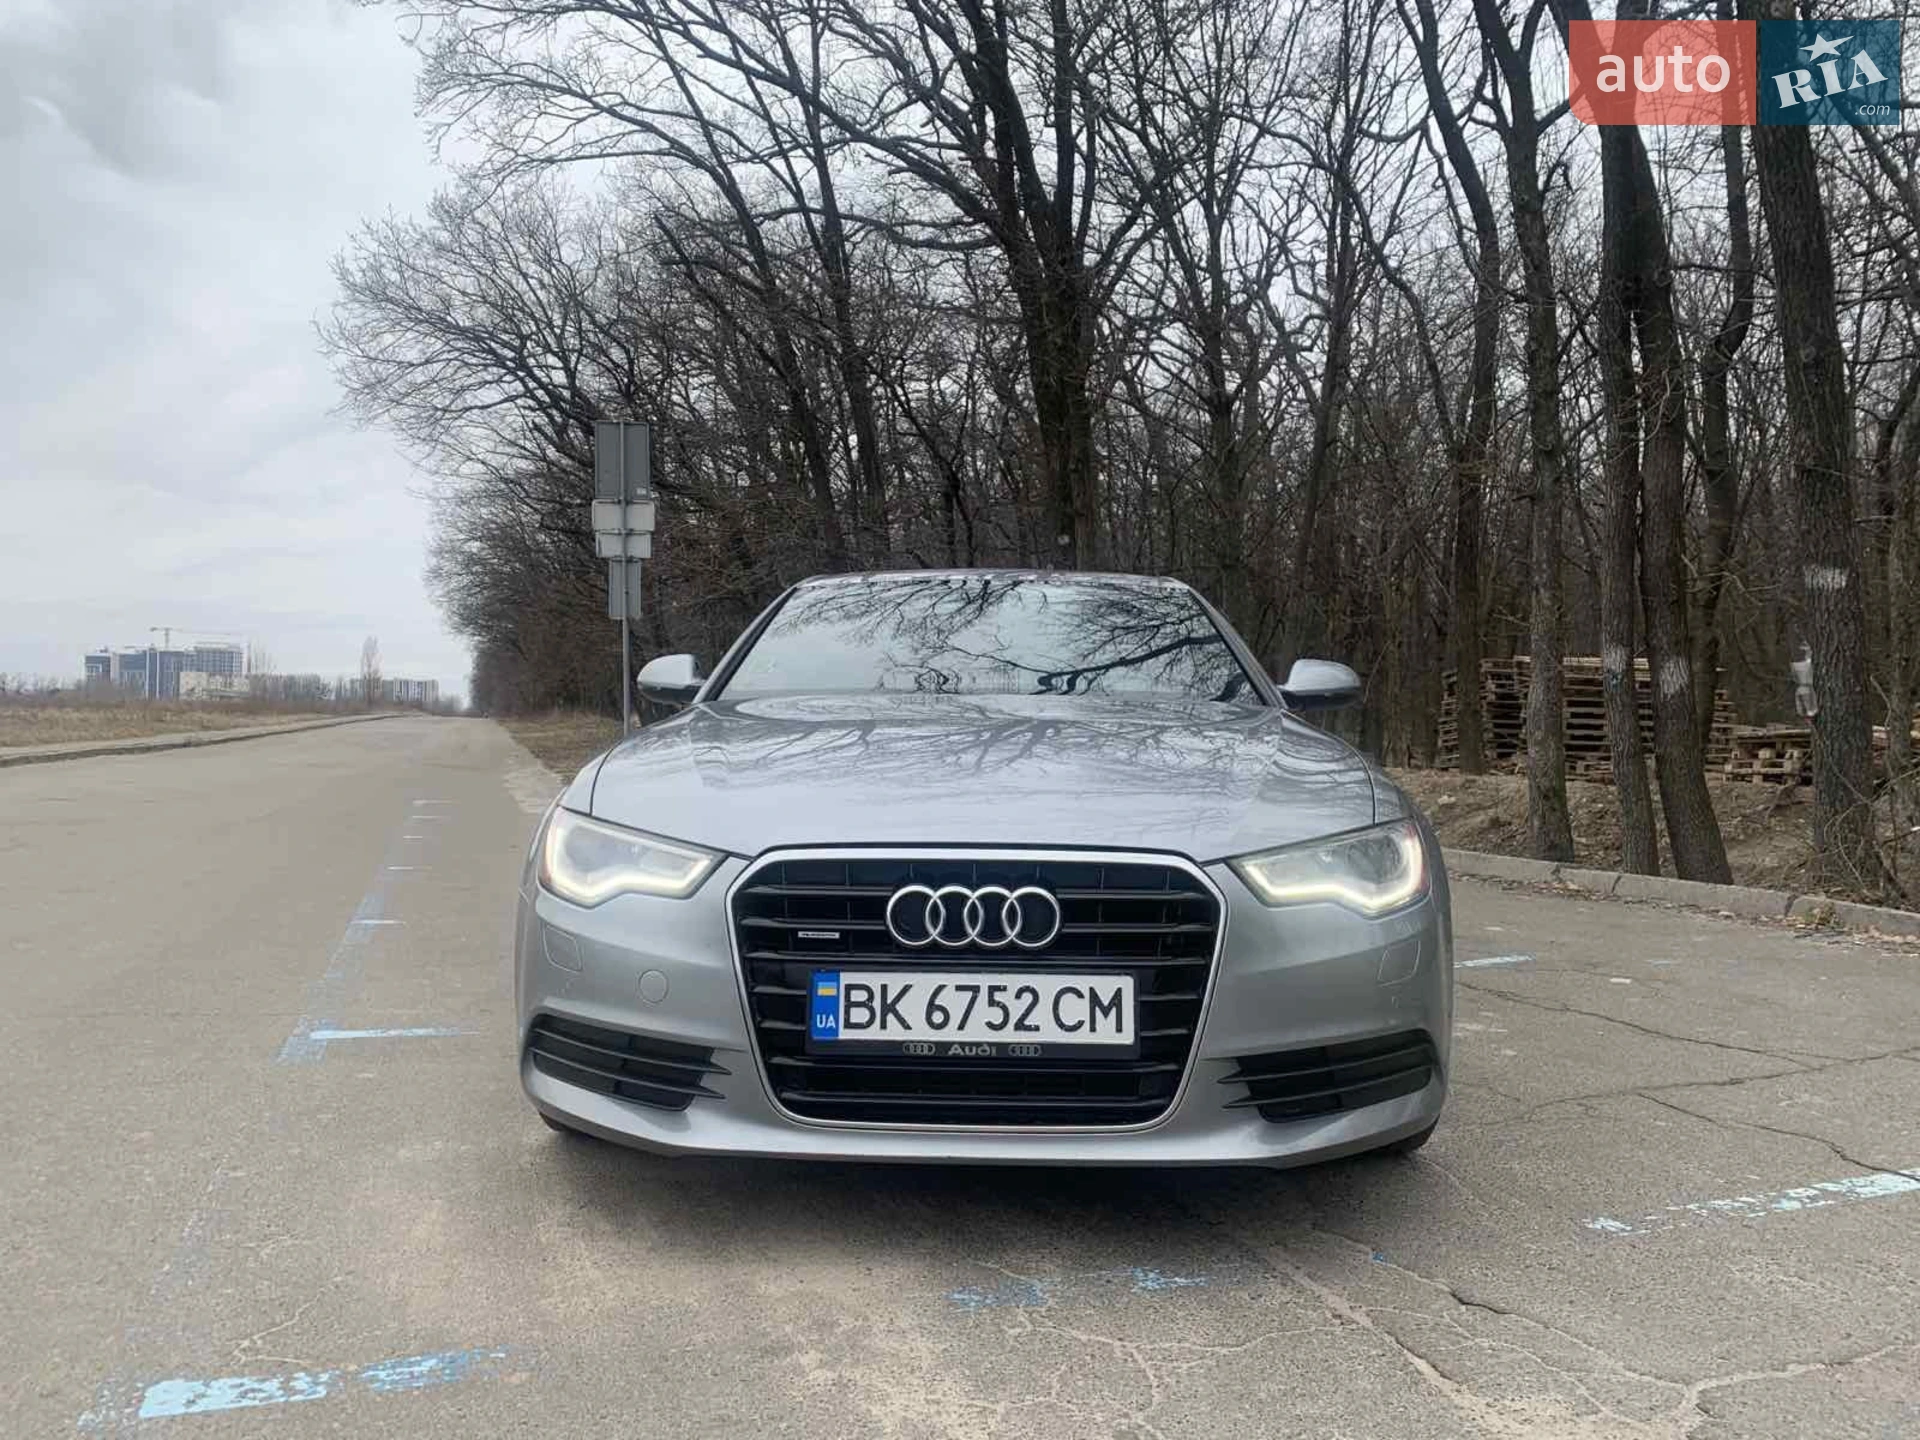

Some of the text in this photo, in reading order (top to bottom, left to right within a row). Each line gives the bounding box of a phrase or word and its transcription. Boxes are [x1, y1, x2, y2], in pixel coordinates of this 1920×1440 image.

[843, 983, 1123, 1034] BK 6752 CM
[816, 1015, 837, 1029] UA
[948, 1043, 997, 1057] Audi
